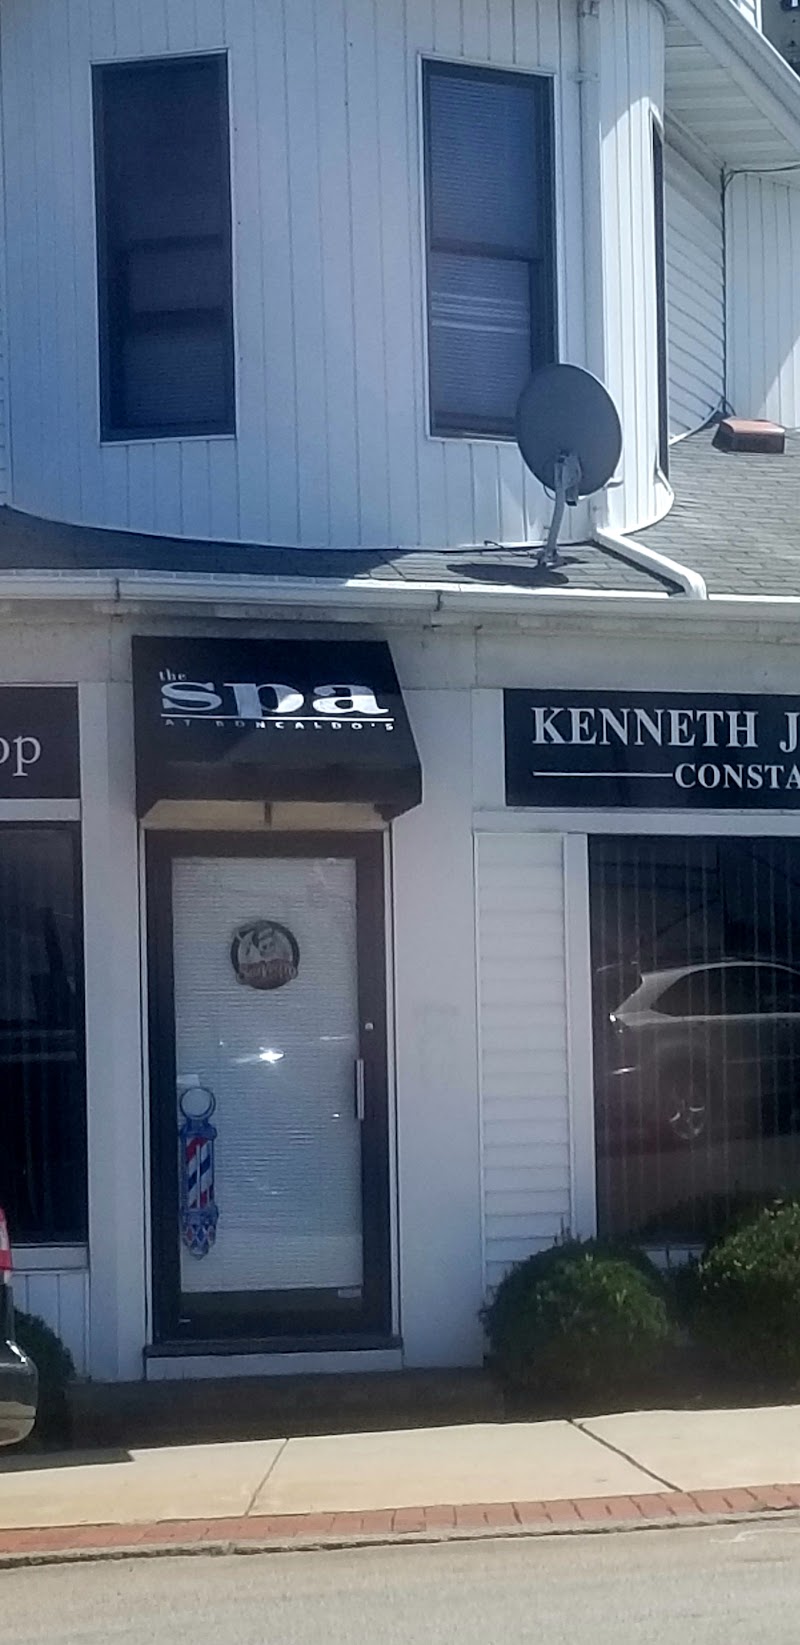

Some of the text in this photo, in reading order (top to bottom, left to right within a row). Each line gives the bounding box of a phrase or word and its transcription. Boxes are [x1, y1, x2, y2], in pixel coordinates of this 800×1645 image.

[159, 669, 187, 681] the
[161, 682, 389, 718] spa
[164, 718, 192, 728] AT
[531, 707, 800, 753] KENNETH J
[674, 763, 800, 790] CONSTA
